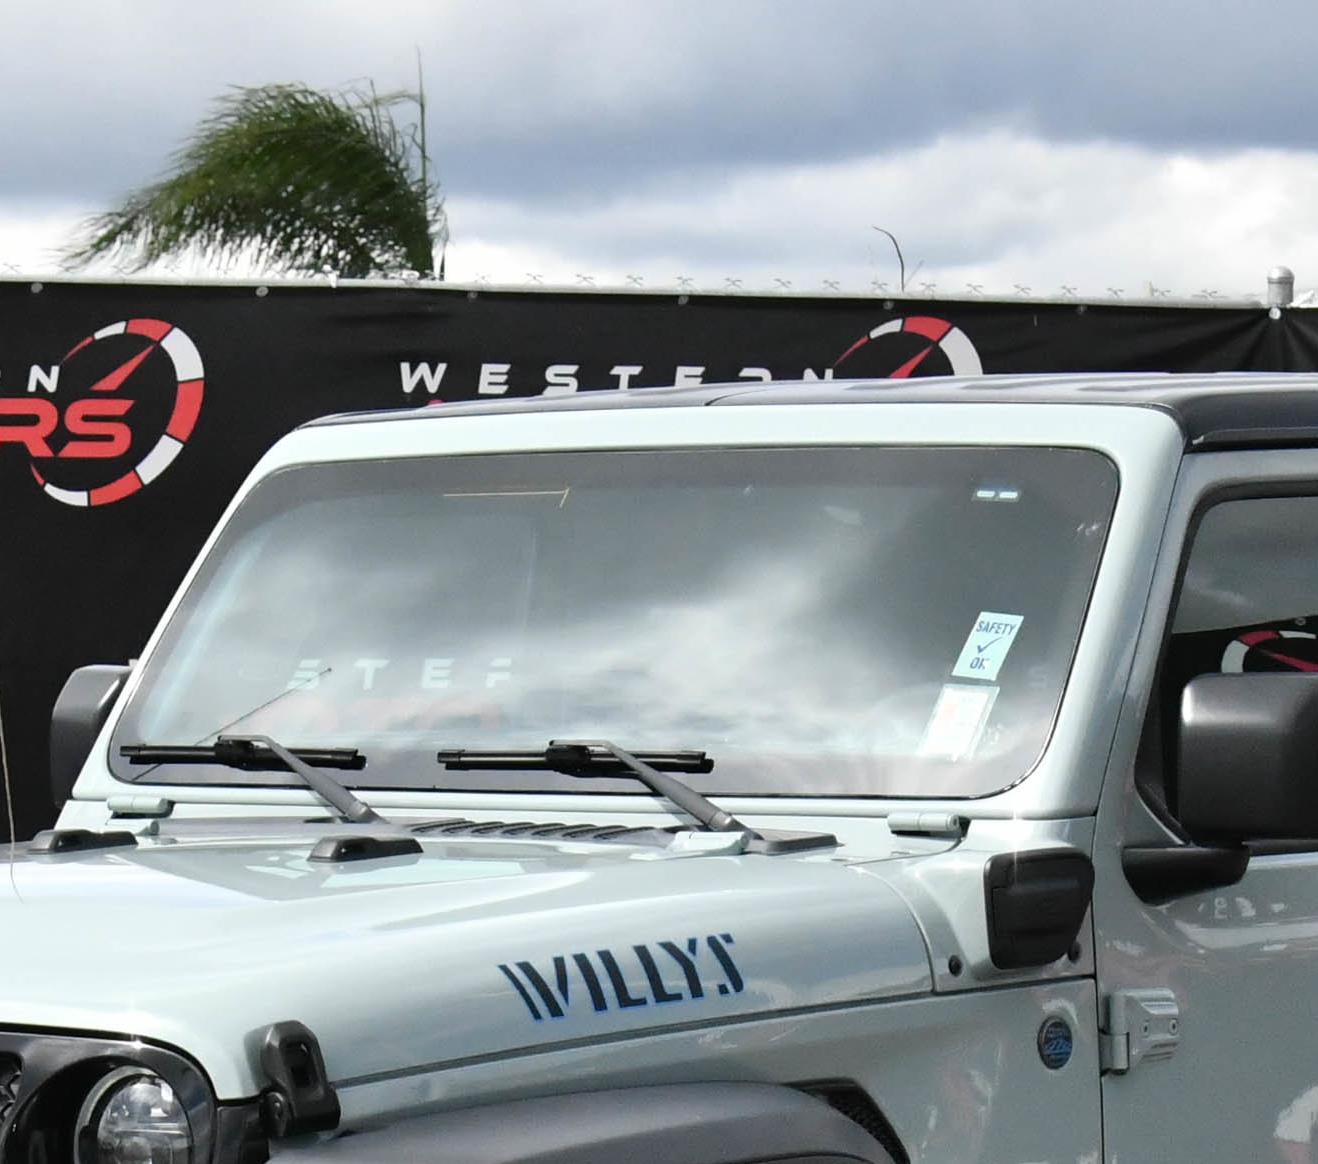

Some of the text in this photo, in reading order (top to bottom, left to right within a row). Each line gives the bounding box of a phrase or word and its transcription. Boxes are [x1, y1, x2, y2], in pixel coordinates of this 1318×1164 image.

[975, 620, 1016, 636] SAFETY
[969, 656, 990, 670] OK
[497, 933, 745, 1021] WILLYS
